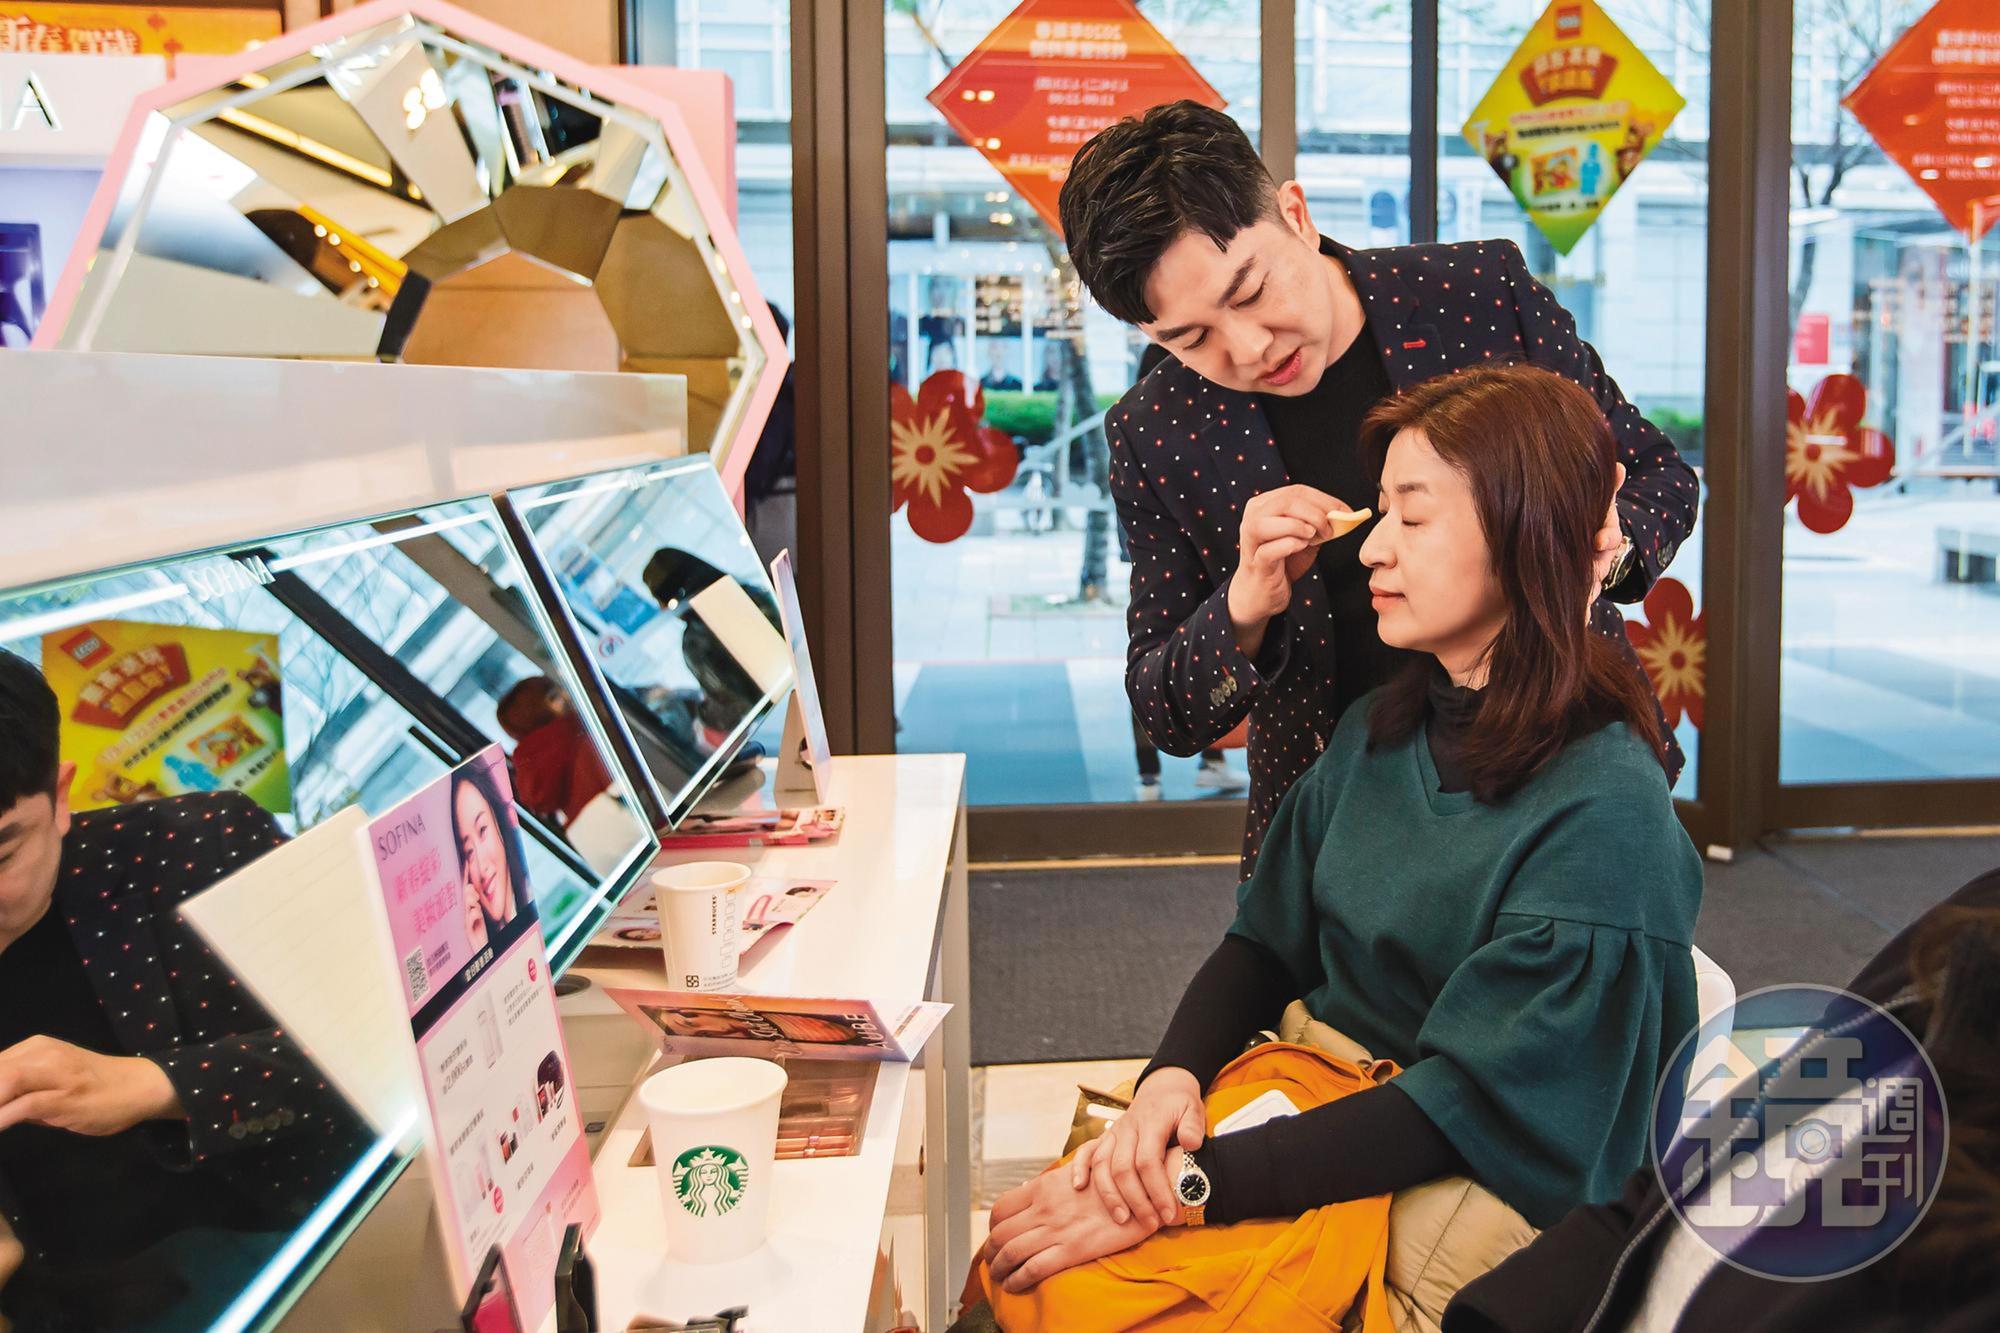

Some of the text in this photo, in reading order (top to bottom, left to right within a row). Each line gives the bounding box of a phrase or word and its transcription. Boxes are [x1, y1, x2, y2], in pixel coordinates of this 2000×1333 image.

[191, 555, 276, 601] SOFINA
[378, 813, 426, 861] SOFINA
[844, 1013, 895, 1051] AUBE
